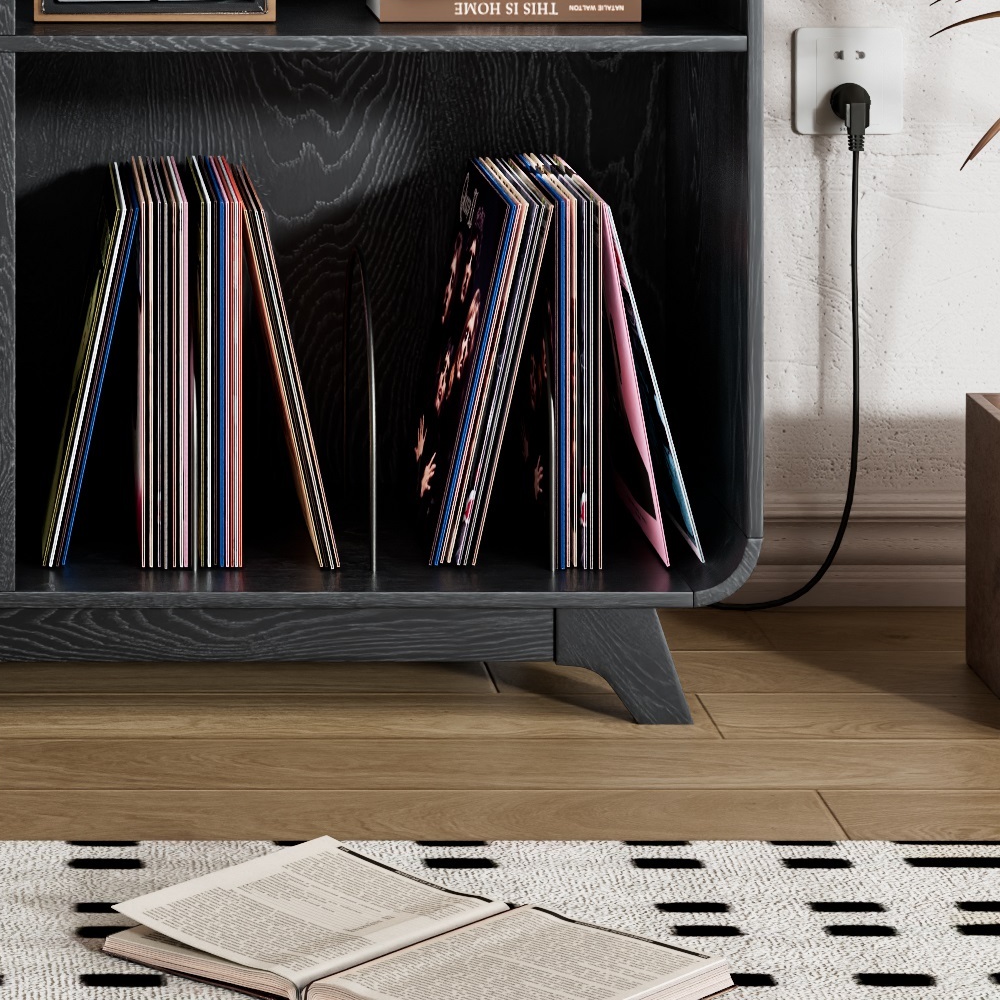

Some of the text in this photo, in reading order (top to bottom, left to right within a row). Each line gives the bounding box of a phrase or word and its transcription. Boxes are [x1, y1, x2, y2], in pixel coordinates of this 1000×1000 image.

[454, 2, 559, 16] THIS IS HOME
[568, 4, 625, 12] NATALIE WALTON
